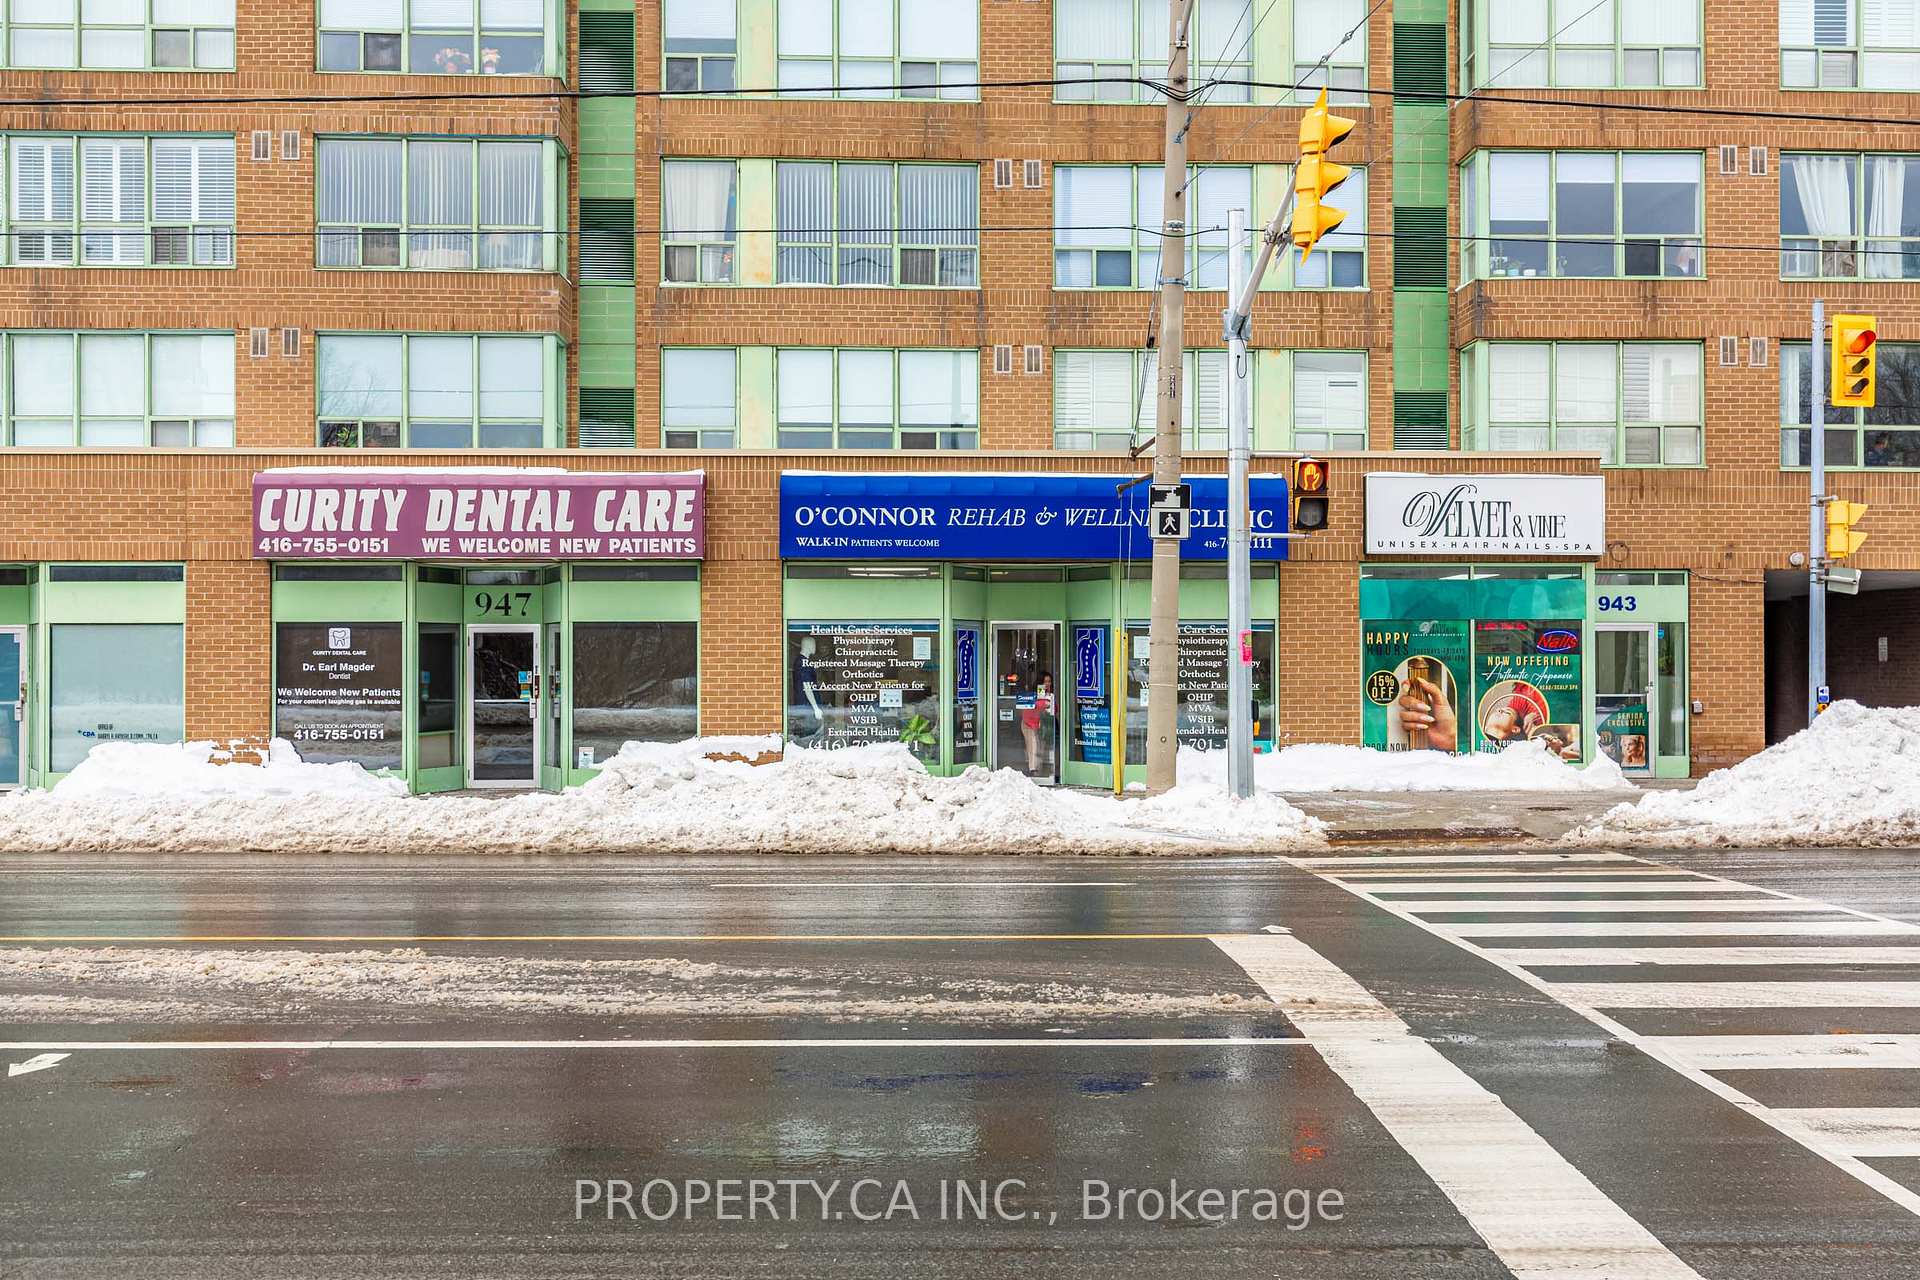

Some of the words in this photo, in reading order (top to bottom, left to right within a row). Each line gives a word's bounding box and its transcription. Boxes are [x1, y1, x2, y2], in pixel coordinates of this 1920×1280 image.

[259, 488, 408, 532] CURITY
[425, 488, 574, 532] DENTAL
[594, 489, 696, 532] CARE
[1402, 484, 1512, 538] VELVET
[1512, 515, 1524, 538] &
[1528, 515, 1566, 538] VINE
[795, 506, 937, 526] O'CONNOR
[947, 507, 1026, 527] REHAB
[1035, 506, 1058, 526] &
[1064, 508, 1151, 528] WELLN
[1190, 509, 1273, 529] CLIIC
[259, 537, 389, 553] 416-755-0151
[421, 537, 450, 553] WE
[458, 537, 551, 553] WELCOME
[559, 537, 601, 553] NEW
[609, 537, 697, 553] PATIENTS
[796, 537, 849, 547] WALK-IN
[851, 539, 893, 547] PATIENTS
[894, 539, 940, 547] WELCOME
[474, 591, 533, 617] 947
[1597, 595, 1637, 611] 943
[810, 625, 847, 634] Health
[847, 625, 872, 634] Care
[873, 625, 913, 634] Services
[1184, 625, 1207, 634] Care
[833, 636, 895, 645] Physiotherapy
[1178, 638, 1229, 648] hysiotherapy
[1366, 632, 1409, 645] HAPPY
[1537, 633, 1578, 649] Nails
[1178, 648, 1227, 657] hiropractic
[801, 659, 848, 668] Registered
[849, 659, 886, 668] Massage
[887, 658, 925, 668] Therapy
[1186, 659, 1223, 668] Massage
[1487, 656, 1510, 666] NOW
[1516, 656, 1569, 666] OFFERING
[302, 663, 316, 671] Dr.
[318, 663, 337, 671] Earl
[339, 663, 376, 673] Magder
[1482, 661, 1529, 684] Authentic
[328, 672, 352, 680] Dentist
[842, 669, 884, 678] Orthotics
[1179, 669, 1221, 678] Orthotics
[819, 681, 850, 690] Accept
[852, 682, 872, 690] New
[874, 681, 911, 690] Patients
[911, 680, 925, 689] for
[1189, 681, 1209, 690] New
[1373, 675, 1395, 687] 15%
[277, 687, 293, 696] We
[294, 687, 337, 696] Welcome
[339, 687, 361, 696] New
[362, 687, 401, 696] Patients
[1371, 686, 1394, 699] OFF
[849, 693, 877, 702] OHIP
[1187, 693, 1214, 701] OHIP
[328, 698, 354, 706] laughing
[850, 704, 875, 713] MVA
[1187, 704, 1213, 712] MVA
[850, 716, 878, 724] WSIB
[1187, 715, 1215, 723] WSIB
[1617, 712, 1643, 720] SENIOR
[1607, 719, 1646, 727] EXCLUSIVE
[294, 730, 385, 740] 416-755-0151
[828, 727, 868, 736] Extended
[870, 727, 900, 736] Health
[1176, 726, 1205, 735] tended
[1207, 726, 1228, 735] Heal
[1390, 742, 1408, 752] NOW
